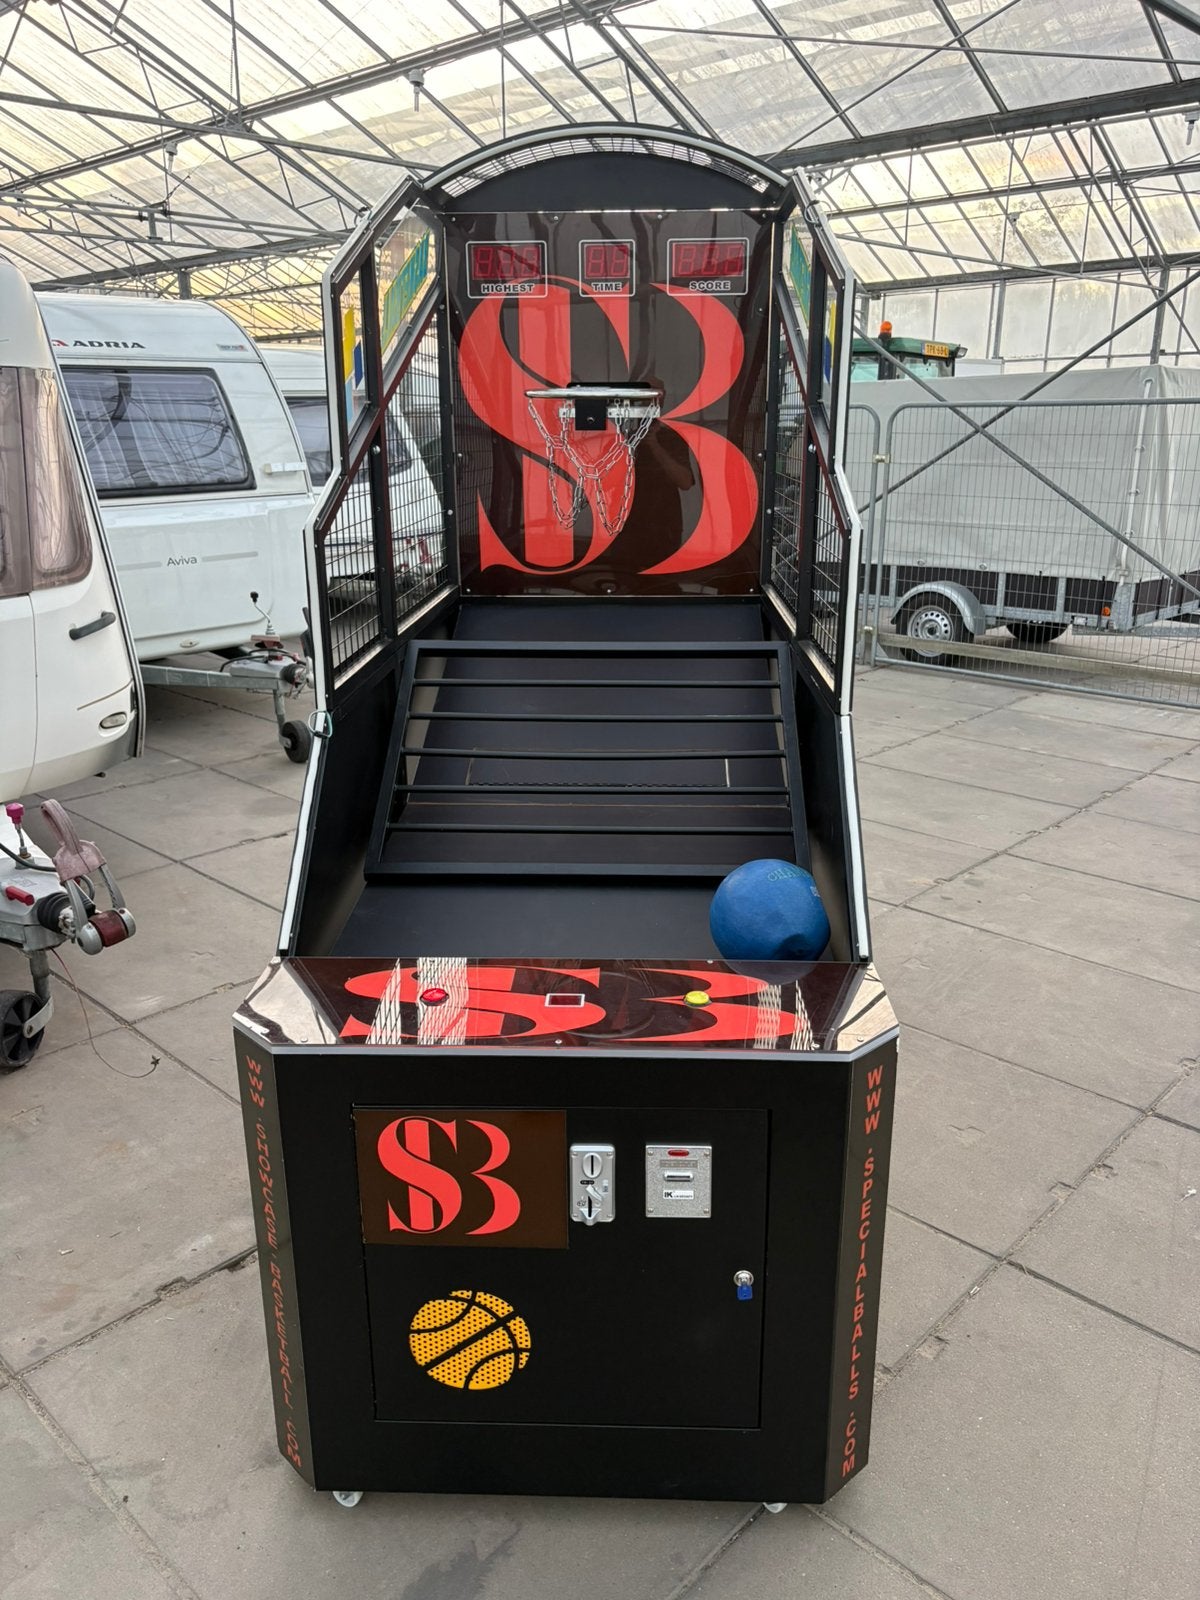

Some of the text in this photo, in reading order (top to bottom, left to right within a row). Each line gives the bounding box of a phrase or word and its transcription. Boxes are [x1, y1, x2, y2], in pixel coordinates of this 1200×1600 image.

[481, 283, 535, 294] HIGHEST
[591, 282, 622, 292] TIME
[689, 280, 731, 291] SCORE
[73, 340, 146, 349] ADRIA
[458, 275, 759, 575] SB
[167, 555, 198, 567] Aviva
[377, 1115, 521, 1235] SB
